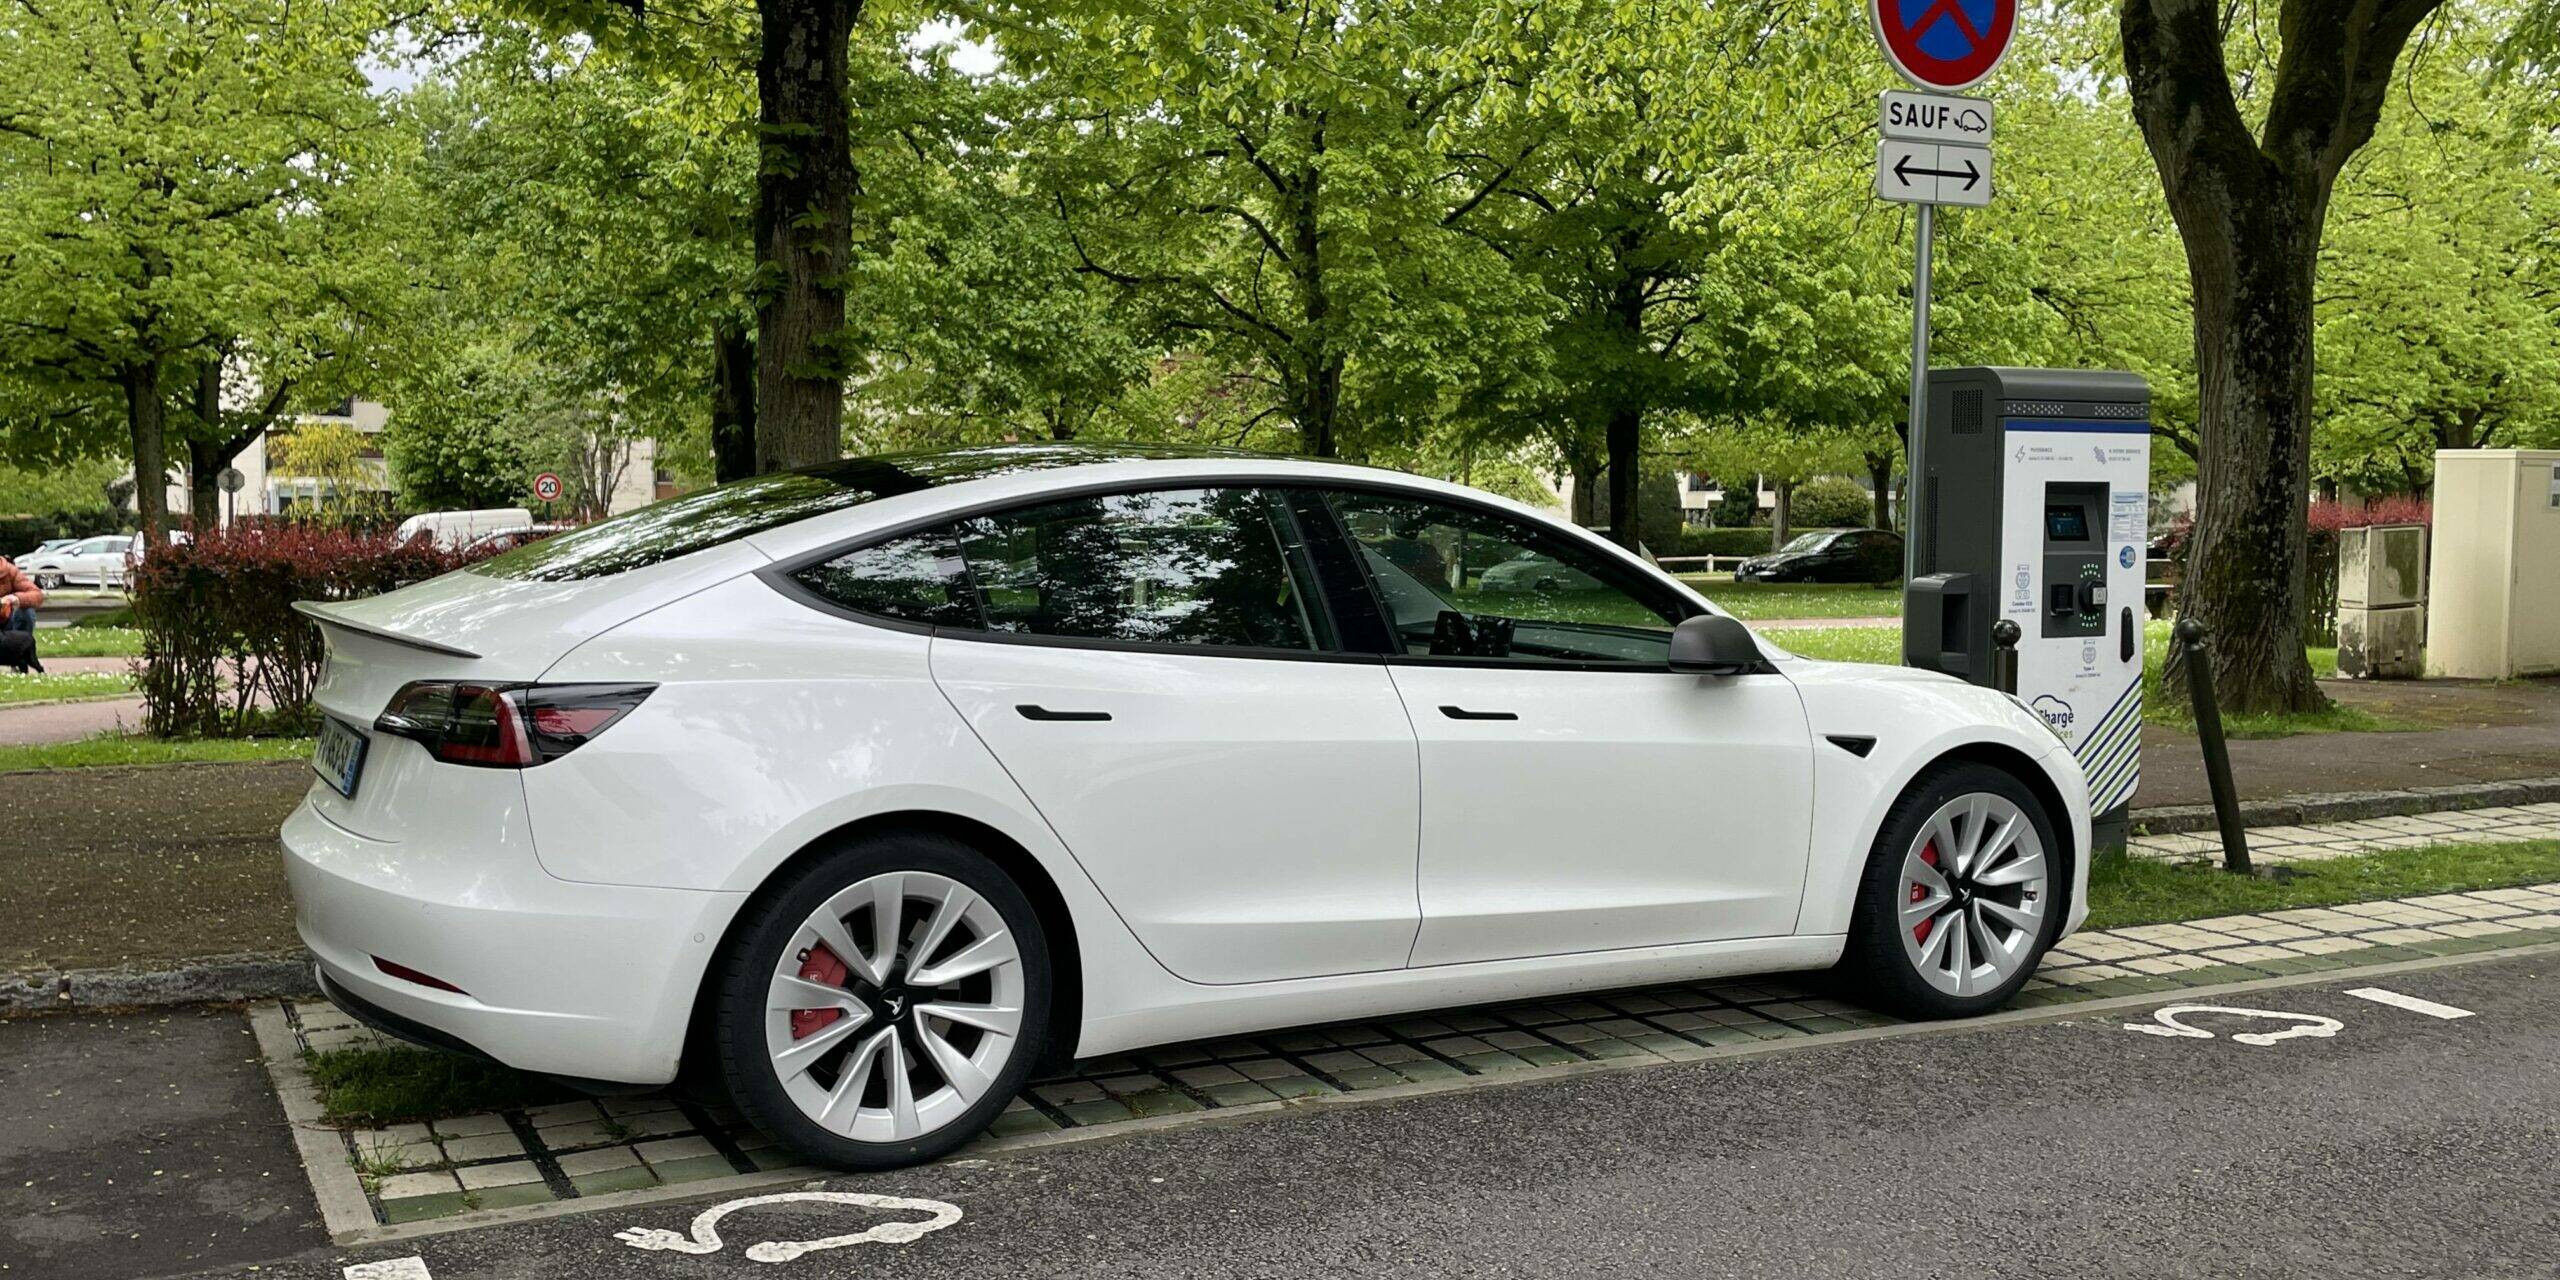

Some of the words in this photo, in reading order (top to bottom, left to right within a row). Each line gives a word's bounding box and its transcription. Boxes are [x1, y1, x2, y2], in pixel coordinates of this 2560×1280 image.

[1889, 101, 1950, 130] SAUF
[541, 482, 557, 493] 20
[2039, 709, 2074, 728] harge
